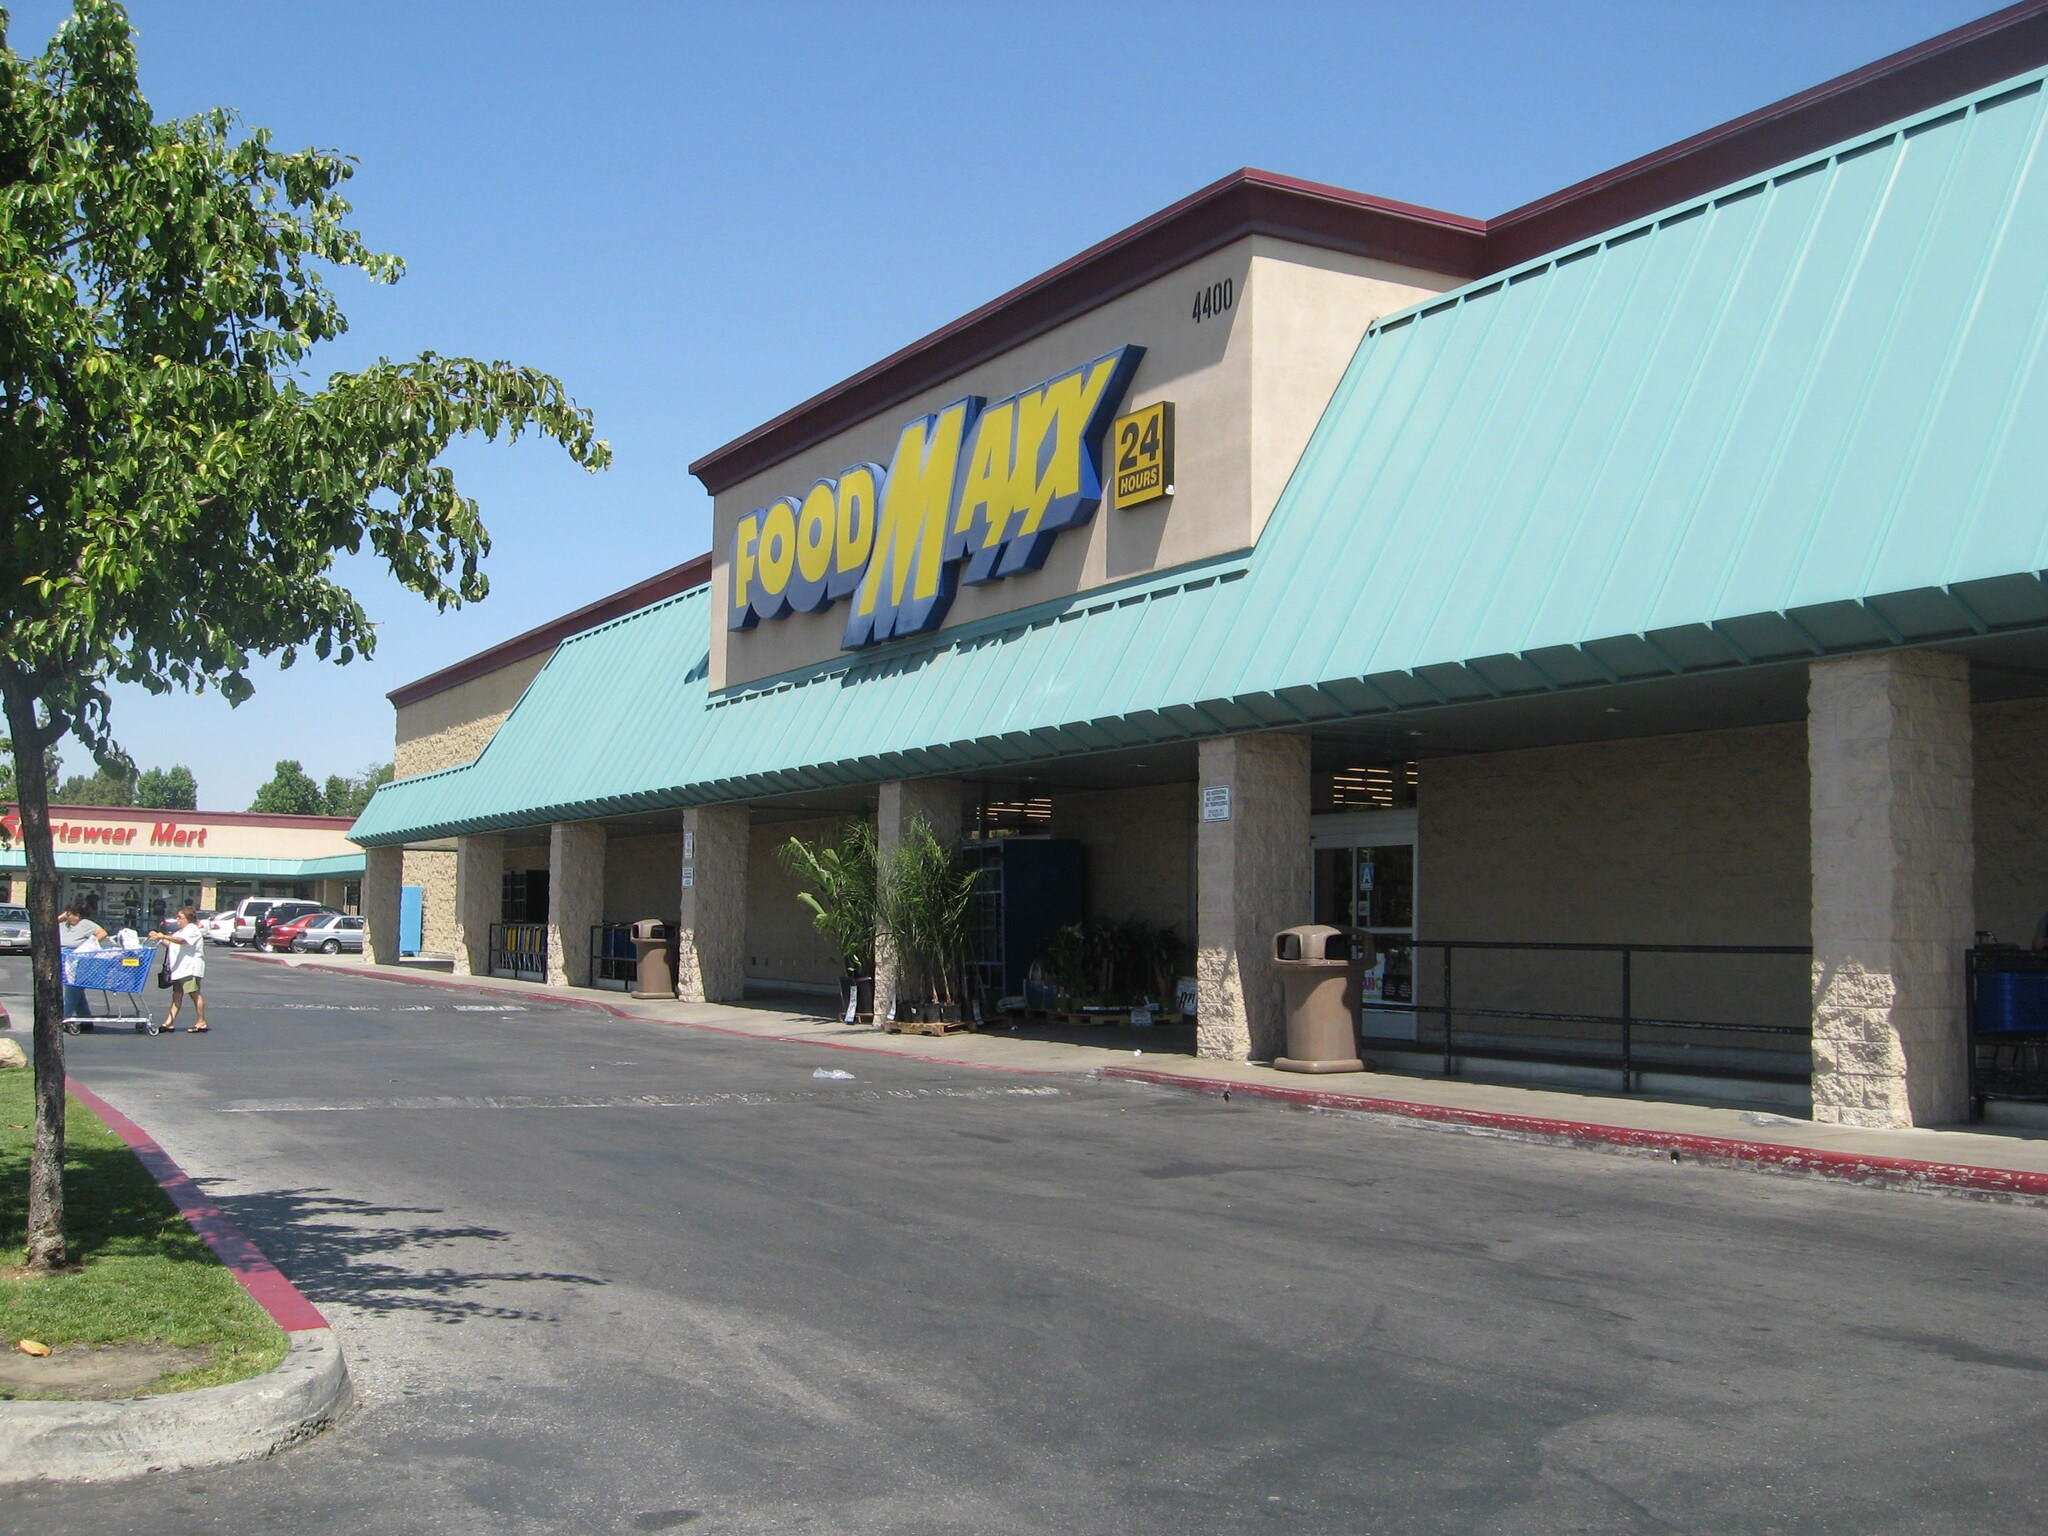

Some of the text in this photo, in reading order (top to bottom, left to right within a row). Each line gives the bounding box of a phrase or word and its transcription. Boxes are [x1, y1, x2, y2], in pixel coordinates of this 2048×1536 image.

[1192, 277, 1232, 324] 4400
[1119, 414, 1160, 472] 24
[1120, 467, 1159, 495] HOURS
[150, 822, 208, 846] Mart
